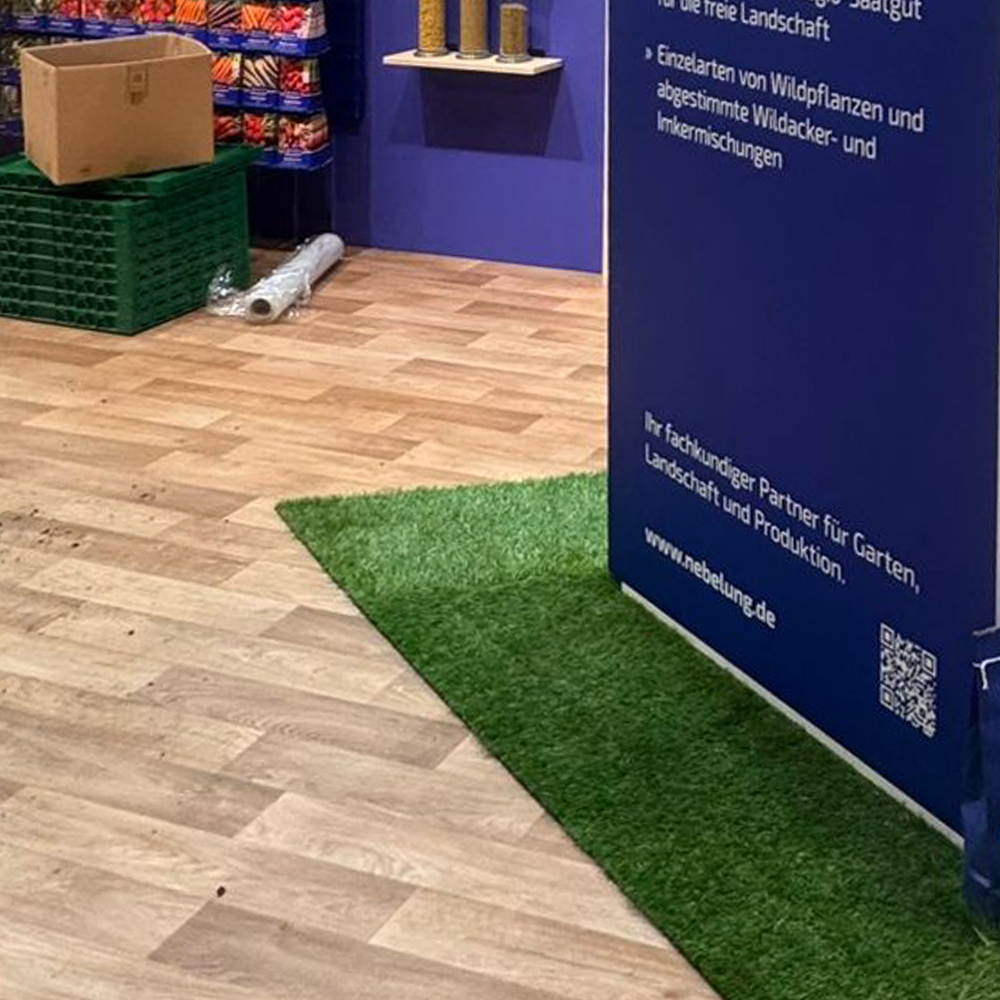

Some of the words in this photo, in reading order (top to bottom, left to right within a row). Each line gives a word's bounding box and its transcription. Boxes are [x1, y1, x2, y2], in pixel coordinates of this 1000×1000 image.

[740, 1, 831, 42] Landschaft
[656, 44, 736, 84] Einzelarten
[738, 69, 767, 90] von
[770, 71, 884, 122] Wildpflanzen
[887, 105, 925, 133] und
[656, 79, 750, 124] abgestimmte
[751, 104, 838, 146] Wildacker-
[842, 132, 877, 160] und
[656, 110, 783, 170] Imkermischungen
[644, 410, 664, 438] Ihr
[664, 422, 756, 490] fachkundiger
[758, 477, 820, 530] Partner
[822, 513, 851, 548] für
[853, 532, 921, 595] Garten,
[644, 442, 720, 507] Landschaft
[722, 493, 751, 526] und
[754, 510, 847, 585] Produktion.
[644, 526, 777, 630] www.nebelung.de
